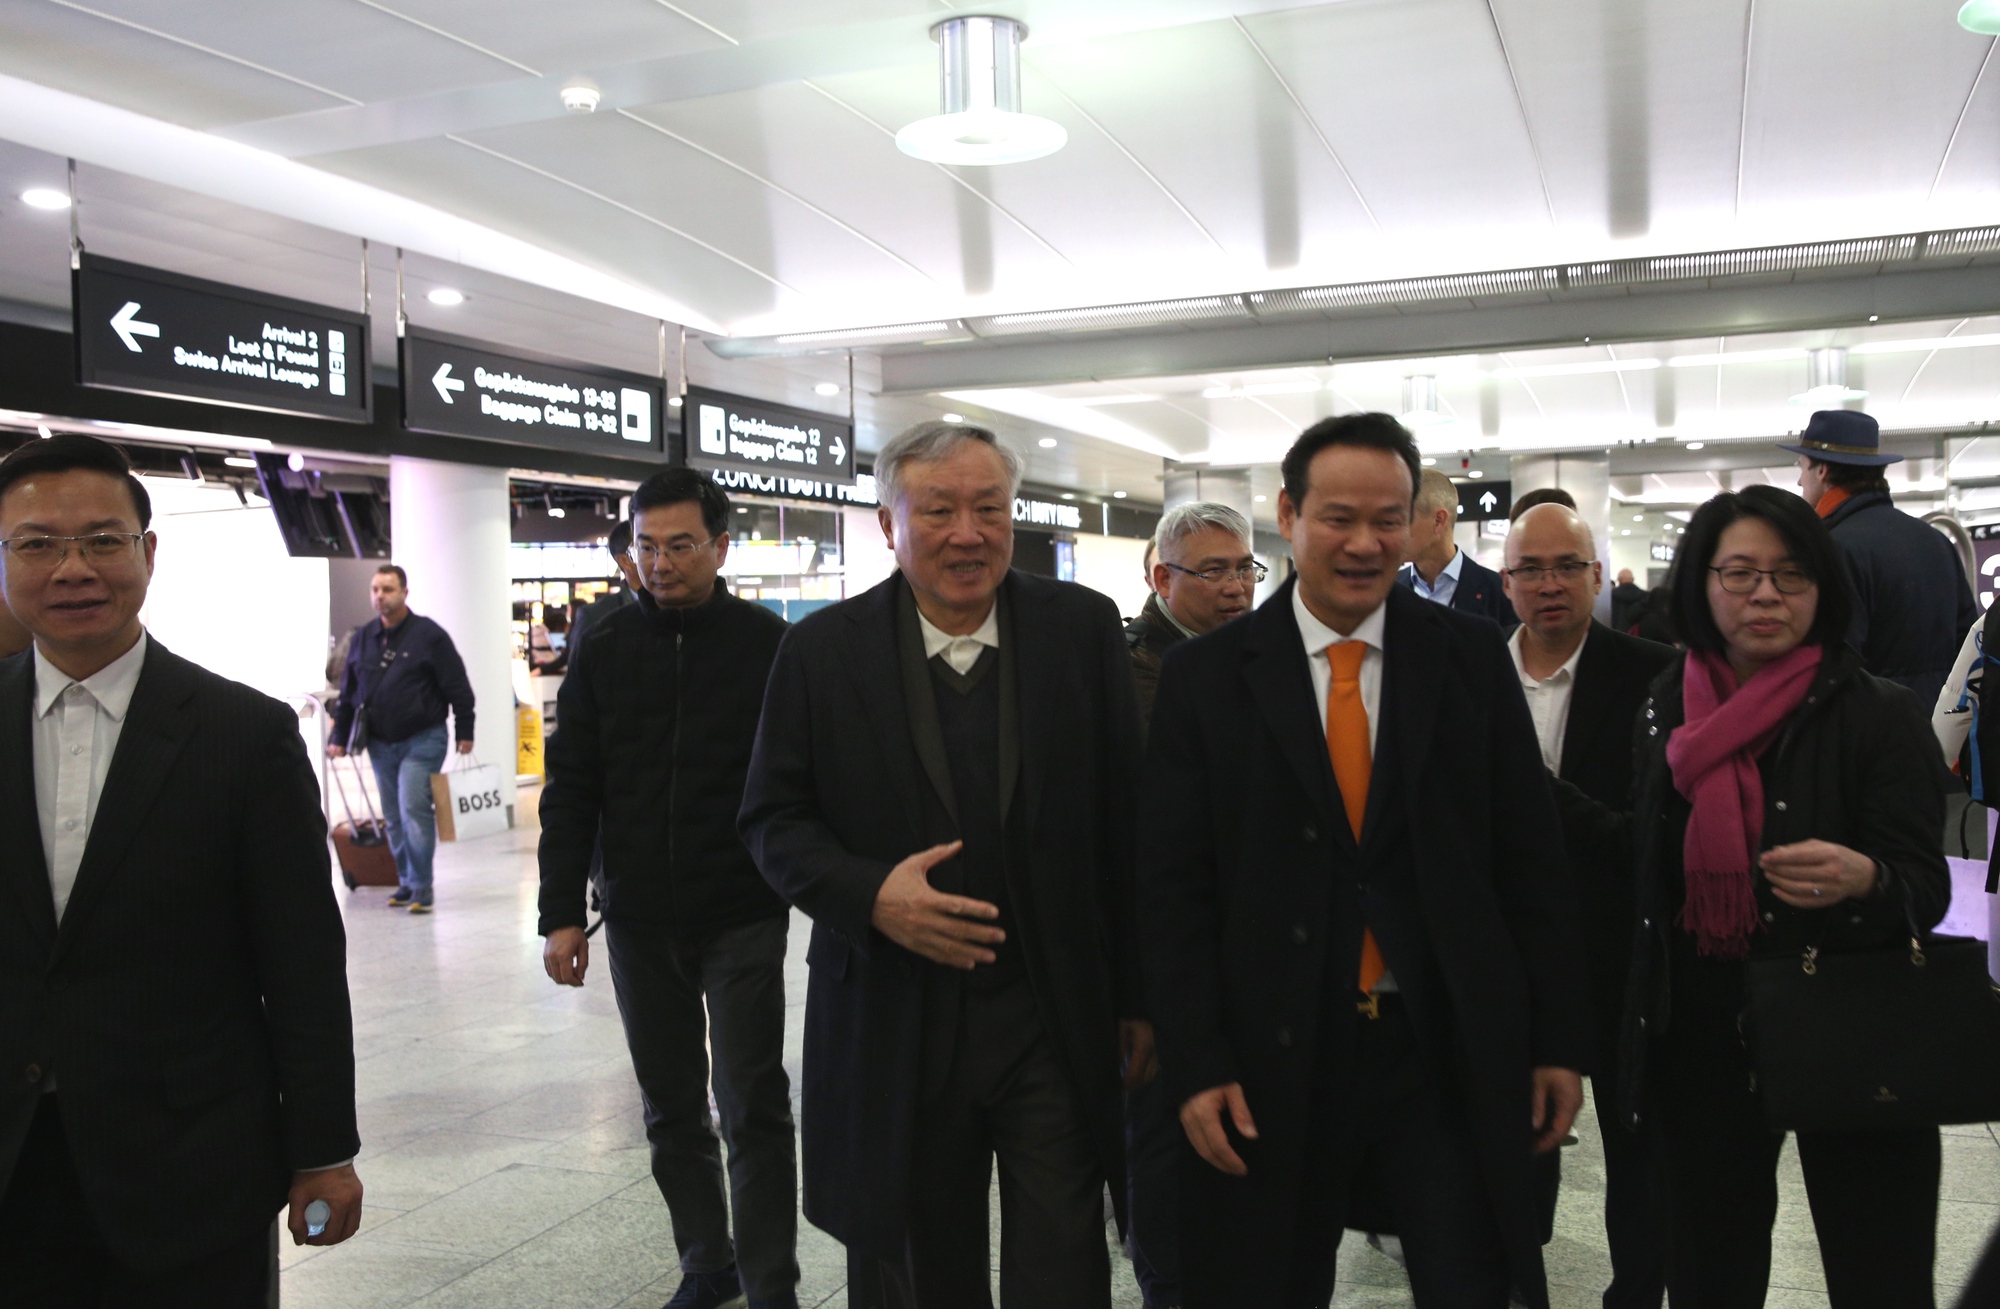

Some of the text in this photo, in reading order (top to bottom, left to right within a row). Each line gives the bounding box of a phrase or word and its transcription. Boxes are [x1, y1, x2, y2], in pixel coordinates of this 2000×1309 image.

[262, 322, 318, 348] Arrival 2
[229, 335, 318, 368] Lost & Found
[174, 347, 319, 389] Swiss Arrival Lounge
[481, 394, 617, 434] Baggage Claim 13-32
[729, 435, 818, 465] Baggage Claim 12
[808, 428, 821, 447] 12
[459, 789, 501, 814] BOSS
